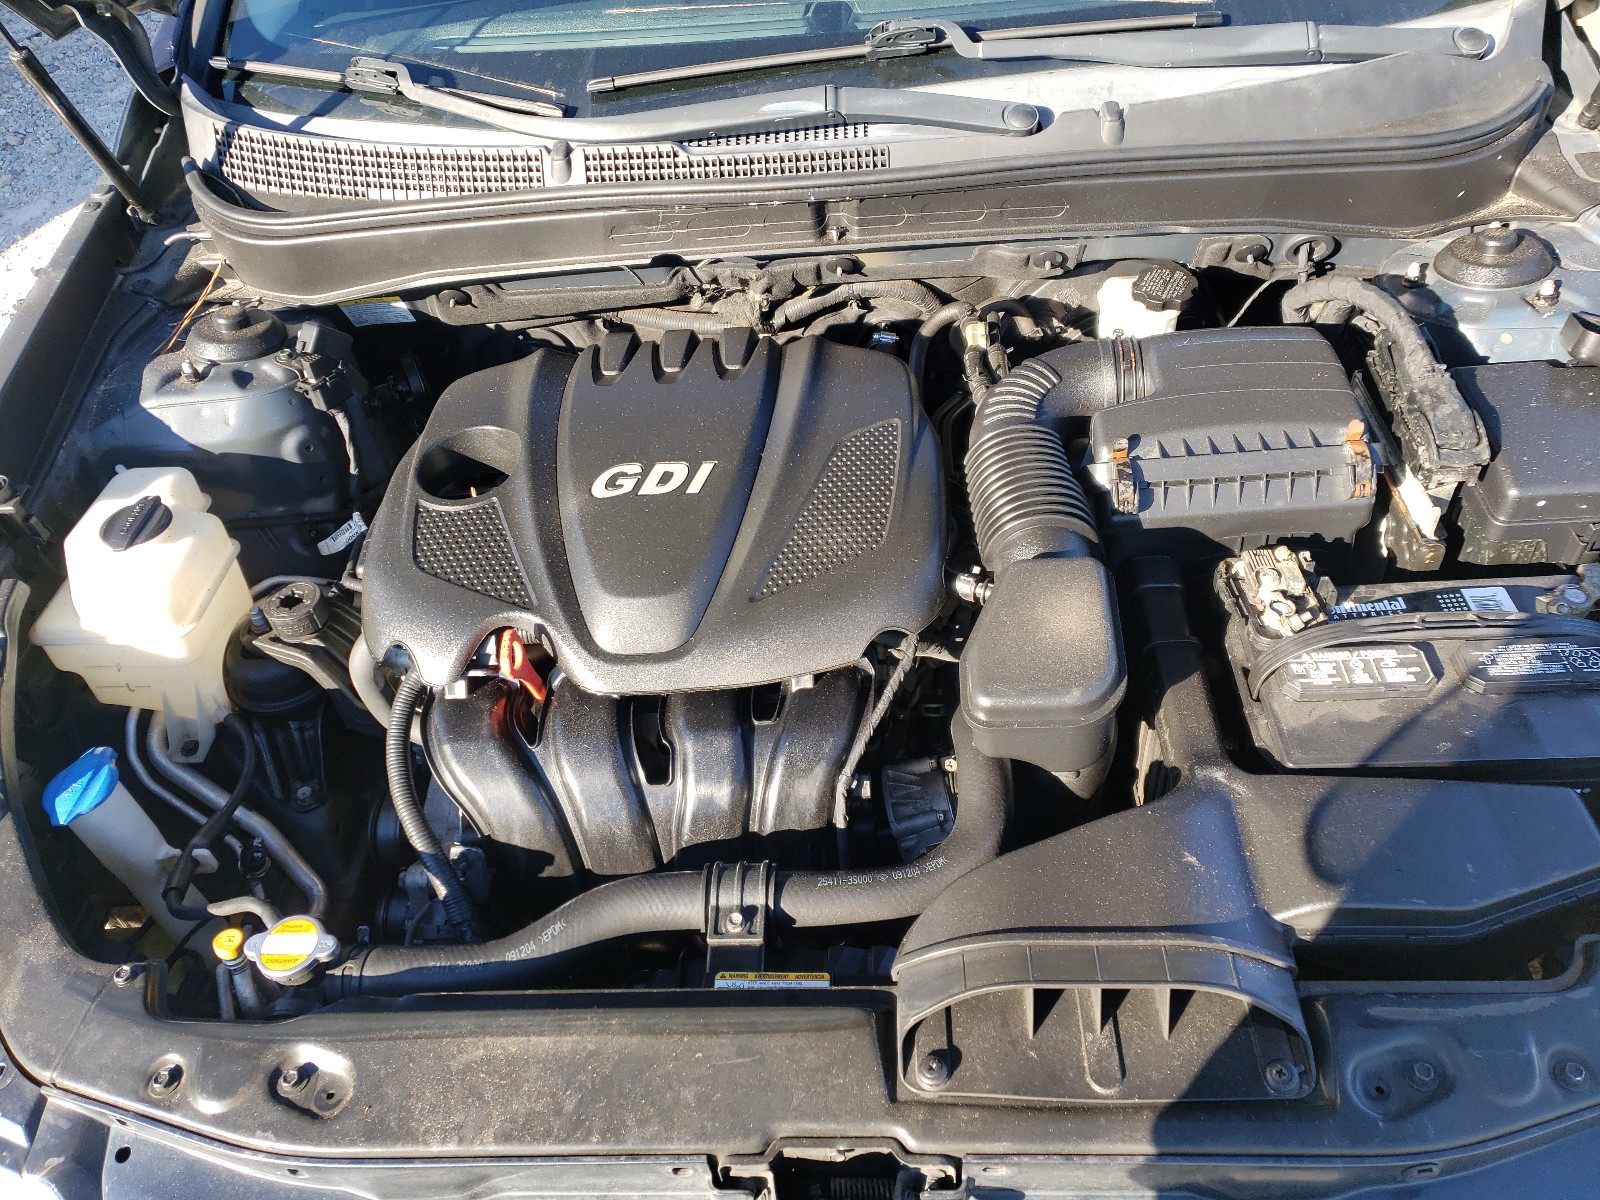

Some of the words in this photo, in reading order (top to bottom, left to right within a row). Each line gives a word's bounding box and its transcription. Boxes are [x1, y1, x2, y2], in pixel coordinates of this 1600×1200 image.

[589, 460, 719, 499] GDI
[891, 867, 921, 880] 091204
[505, 940, 536, 962] 091204
